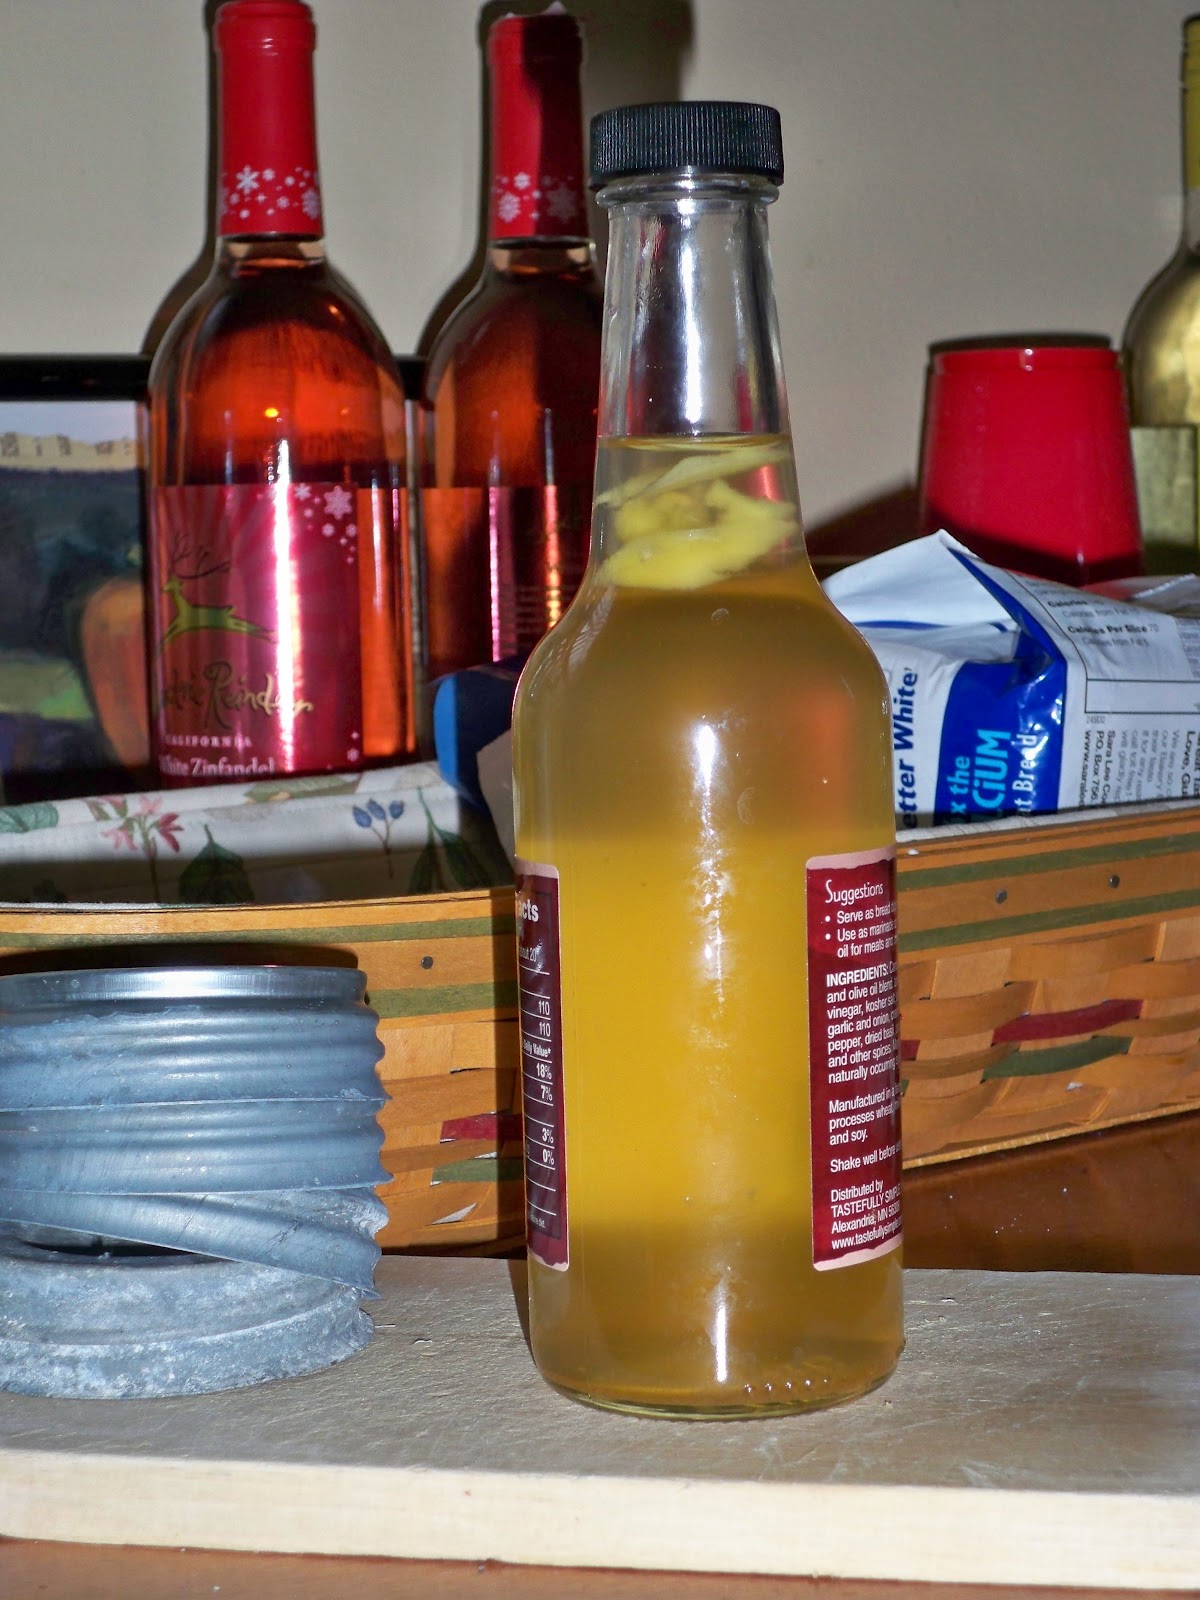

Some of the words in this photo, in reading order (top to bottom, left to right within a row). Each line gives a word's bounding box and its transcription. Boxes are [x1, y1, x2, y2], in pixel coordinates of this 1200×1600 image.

[893, 672, 918, 751] White
[1106, 730, 1116, 758] Sara
[190, 756, 275, 777] Zinfandel
[947, 755, 971, 795] the
[972, 729, 1012, 810] CiUM
[1093, 755, 1102, 776] Box
[1104, 760, 1113, 781] Lee
[825, 879, 883, 906] Suggestions
[837, 911, 863, 924] Serve
[865, 909, 874, 920] as
[875, 902, 890, 917] bread
[837, 928, 856, 942] Use
[858, 928, 868, 938] as
[838, 944, 848, 958] oil
[851, 943, 862, 956] for
[865, 939, 884, 953] meats
[827, 963, 888, 987] INGREDIENTS:
[827, 989, 846, 1003] and
[848, 986, 868, 1000] olive
[538, 1001, 550, 1016] 110
[827, 1004, 863, 1019] vinegar,
[866, 997, 887, 1012] kosher
[539, 1021, 551, 1037] 110
[828, 1020, 854, 1039] garlic
[856, 1016, 871, 1031] and
[828, 1037, 863, 1055] pepper,
[865, 1029, 882, 1044] dried
[828, 1053, 847, 1068] and
[850, 1050, 871, 1064] other
[536, 1062, 552, 1080] 18%
[829, 1066, 868, 1084] naturally
[541, 1085, 553, 1101] 7%
[829, 1089, 885, 1113] Manufactured
[829, 1111, 874, 1133] processes
[542, 1128, 554, 1144] 3%
[830, 1130, 848, 1145] and
[851, 1129, 868, 1142] soy.
[542, 1148, 555, 1165] 0%
[830, 1156, 860, 1172] Shake
[863, 1150, 877, 1165] well
[879, 1145, 895, 1160] before
[831, 1181, 874, 1202] Distributed
[875, 1180, 883, 1193] by
[831, 1193, 884, 1218] TASTEFULLY
[831, 1213, 876, 1234] Alexandria,
[878, 1207, 887, 1222] MN
